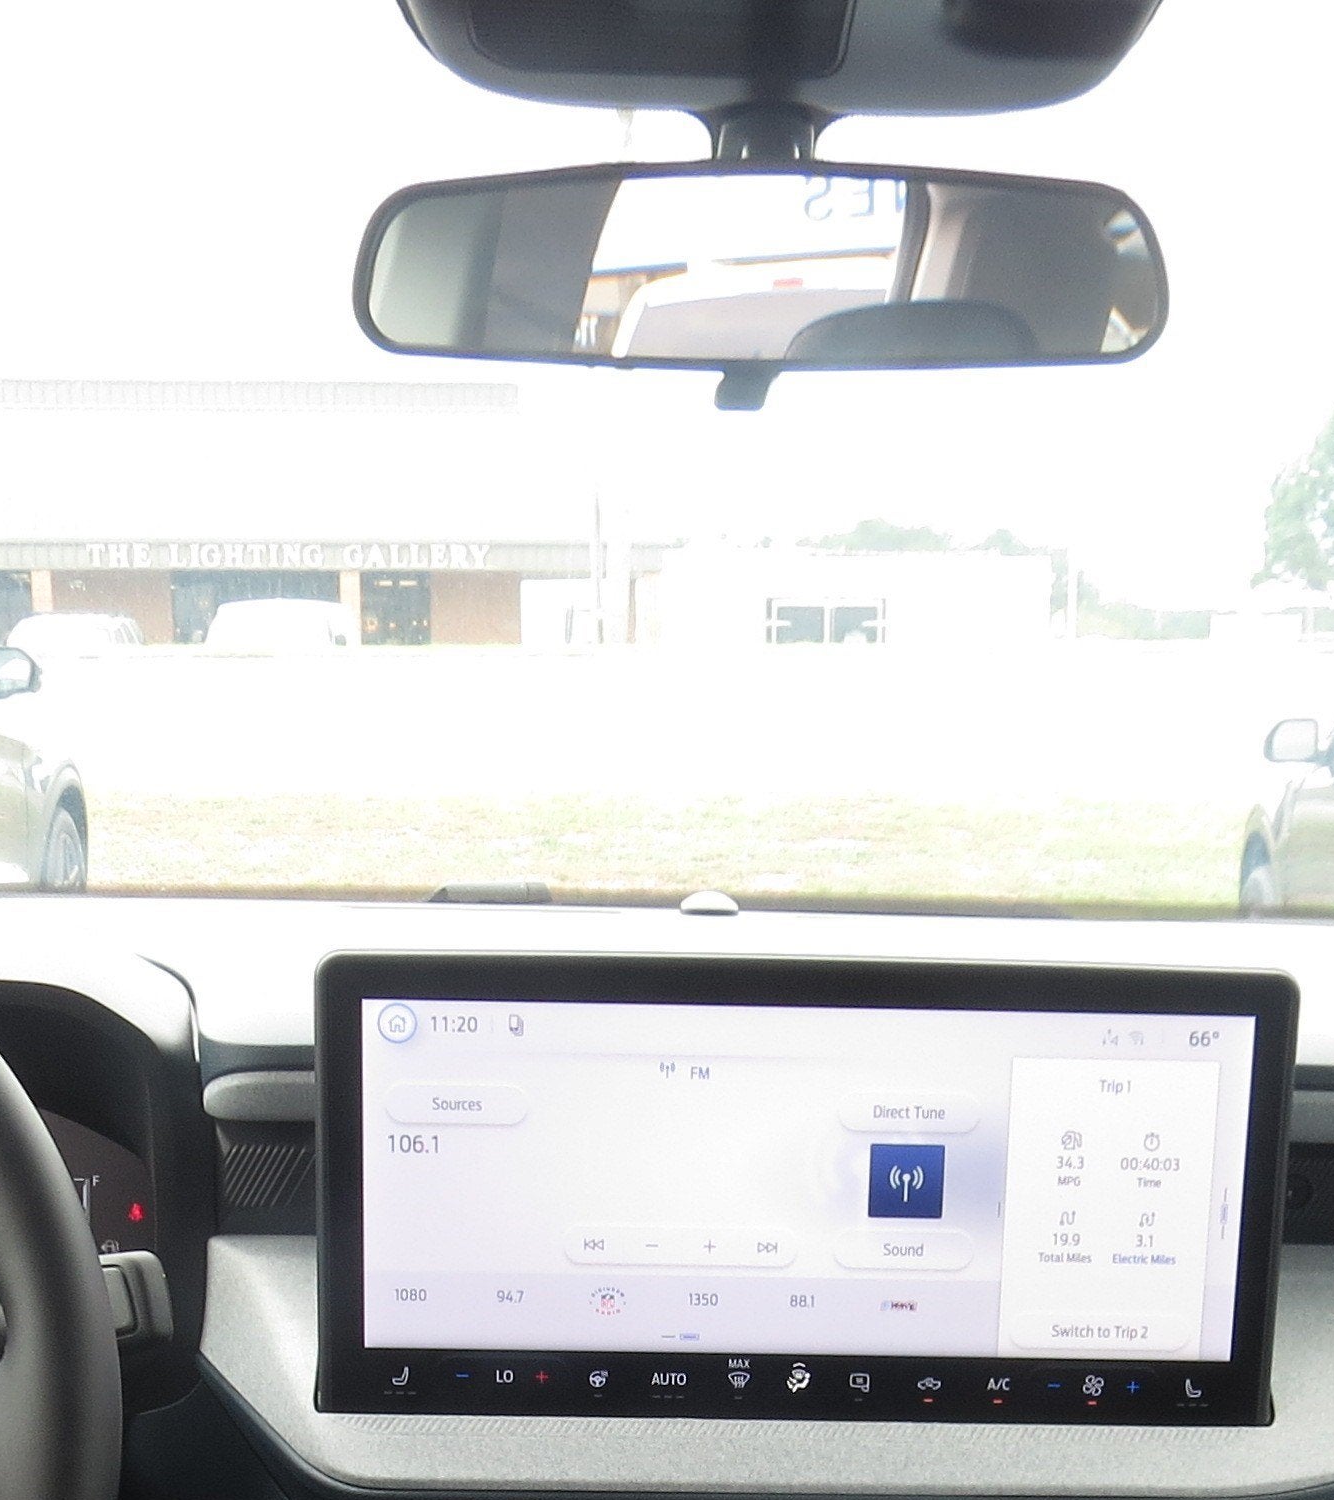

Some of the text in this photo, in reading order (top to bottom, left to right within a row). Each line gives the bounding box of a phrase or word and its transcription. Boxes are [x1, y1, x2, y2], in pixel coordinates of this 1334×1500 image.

[85, 543, 491, 568] THE LIGHTING GALLERY
[430, 1015, 478, 1033] 11:20
[690, 1066, 710, 1080] FM
[1099, 1079, 1124, 1094] Trip
[431, 1096, 483, 1112] Sources
[873, 1104, 946, 1120] Direct Tune
[387, 1134, 441, 1154] 106.1
[1056, 1155, 1085, 1170] 34.3
[1120, 1157, 1181, 1171] 00:40:03
[92, 1175, 101, 1186] F
[1057, 1175, 1081, 1187] MPG
[1136, 1177, 1162, 1189] Time
[1052, 1232, 1081, 1247] 19.9
[1135, 1234, 1155, 1248] 3.1
[882, 1242, 925, 1257] Sound
[1038, 1252, 1092, 1264] Total Miles
[1112, 1253, 1176, 1265] Electric Miles
[395, 1288, 427, 1302] 1080
[496, 1289, 525, 1304] 94.7
[688, 1292, 719, 1307] 1350
[789, 1294, 816, 1308] 88.1
[1051, 1324, 1149, 1341] Switch to Trip 2
[728, 1358, 751, 1369] MAX
[495, 1369, 514, 1384] LO
[651, 1372, 687, 1386] AUTO
[986, 1377, 1011, 1391] A/C
